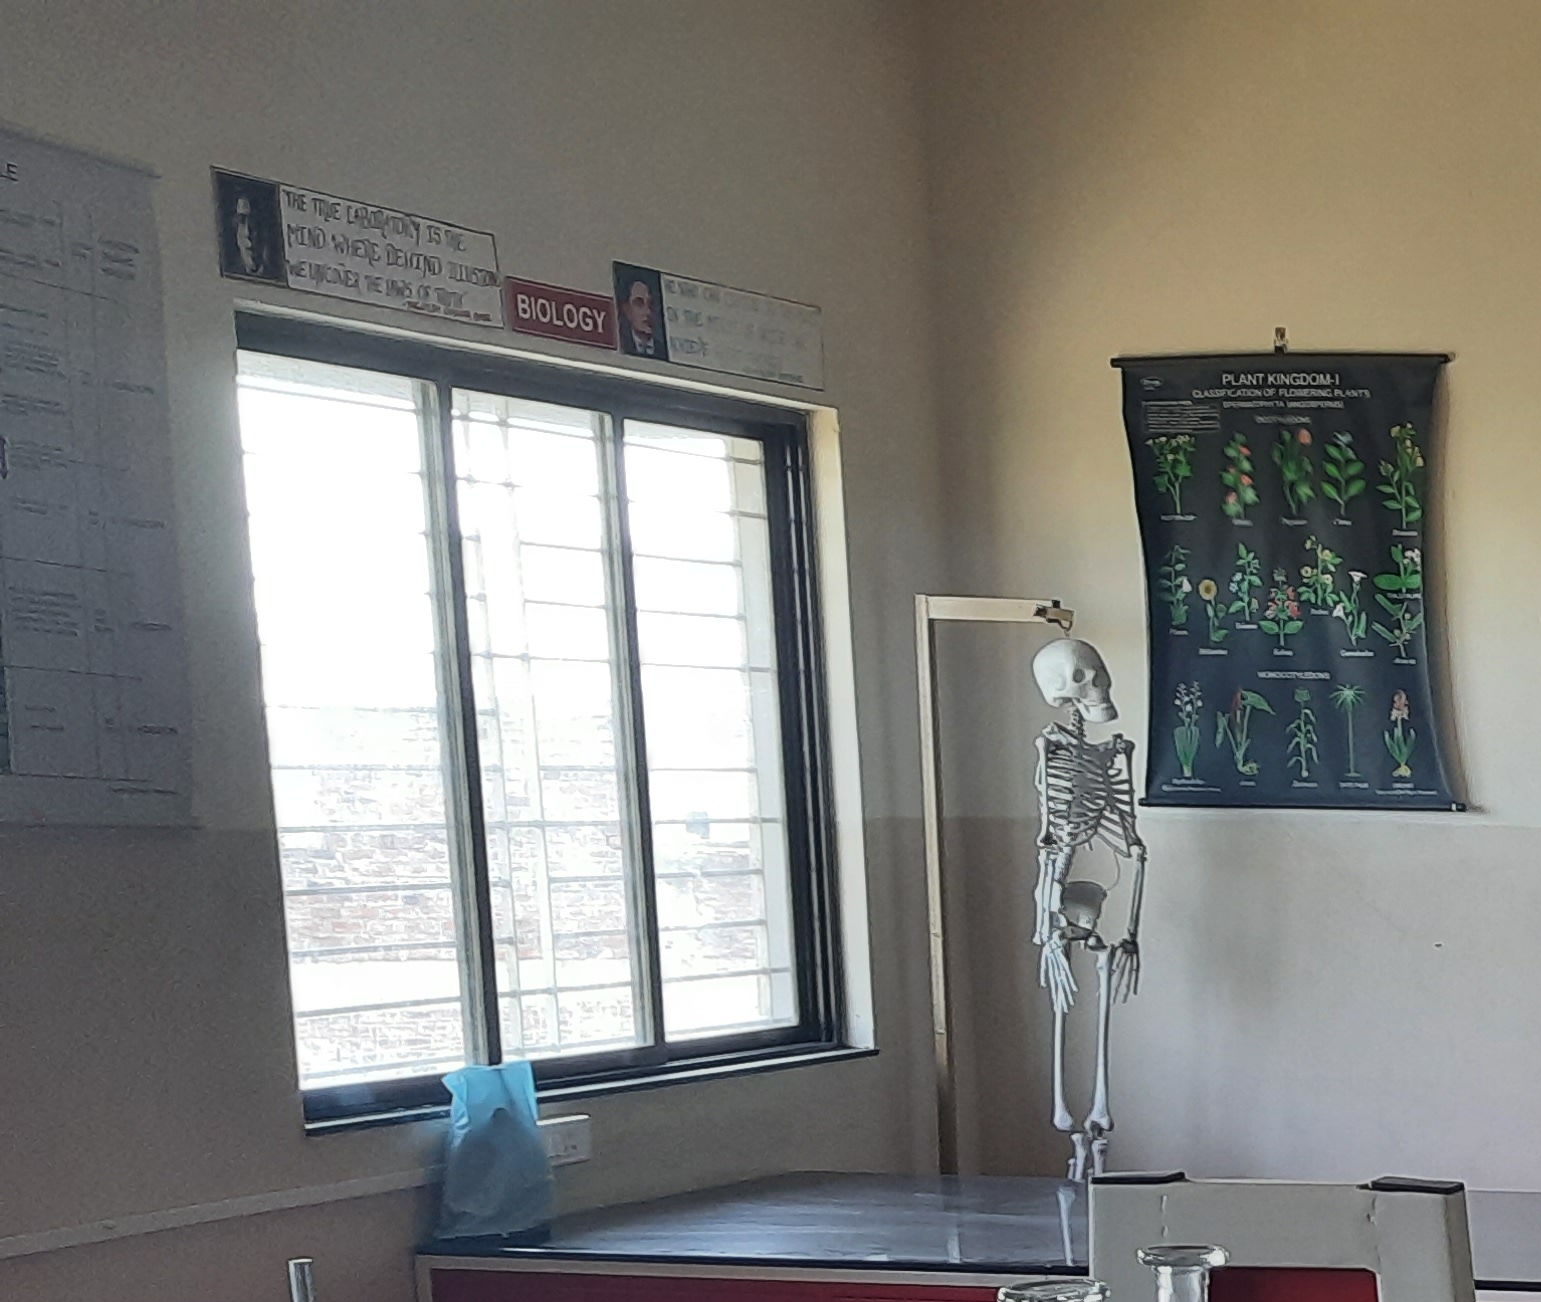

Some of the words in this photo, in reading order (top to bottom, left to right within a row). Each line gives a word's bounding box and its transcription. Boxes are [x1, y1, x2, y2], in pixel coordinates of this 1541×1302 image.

[283, 189, 307, 212] THE
[311, 198, 341, 222] TRUE
[427, 225, 441, 245] IS
[287, 224, 327, 249] MIND
[331, 234, 381, 267] WHERE
[517, 294, 606, 333] BIOLOGY
[1192, 388, 1262, 398] CLASSIFICATION
[1264, 388, 1276, 398] OF
[1222, 373, 1265, 386] PLANT
[1267, 373, 1340, 386] KINGDOM-I
